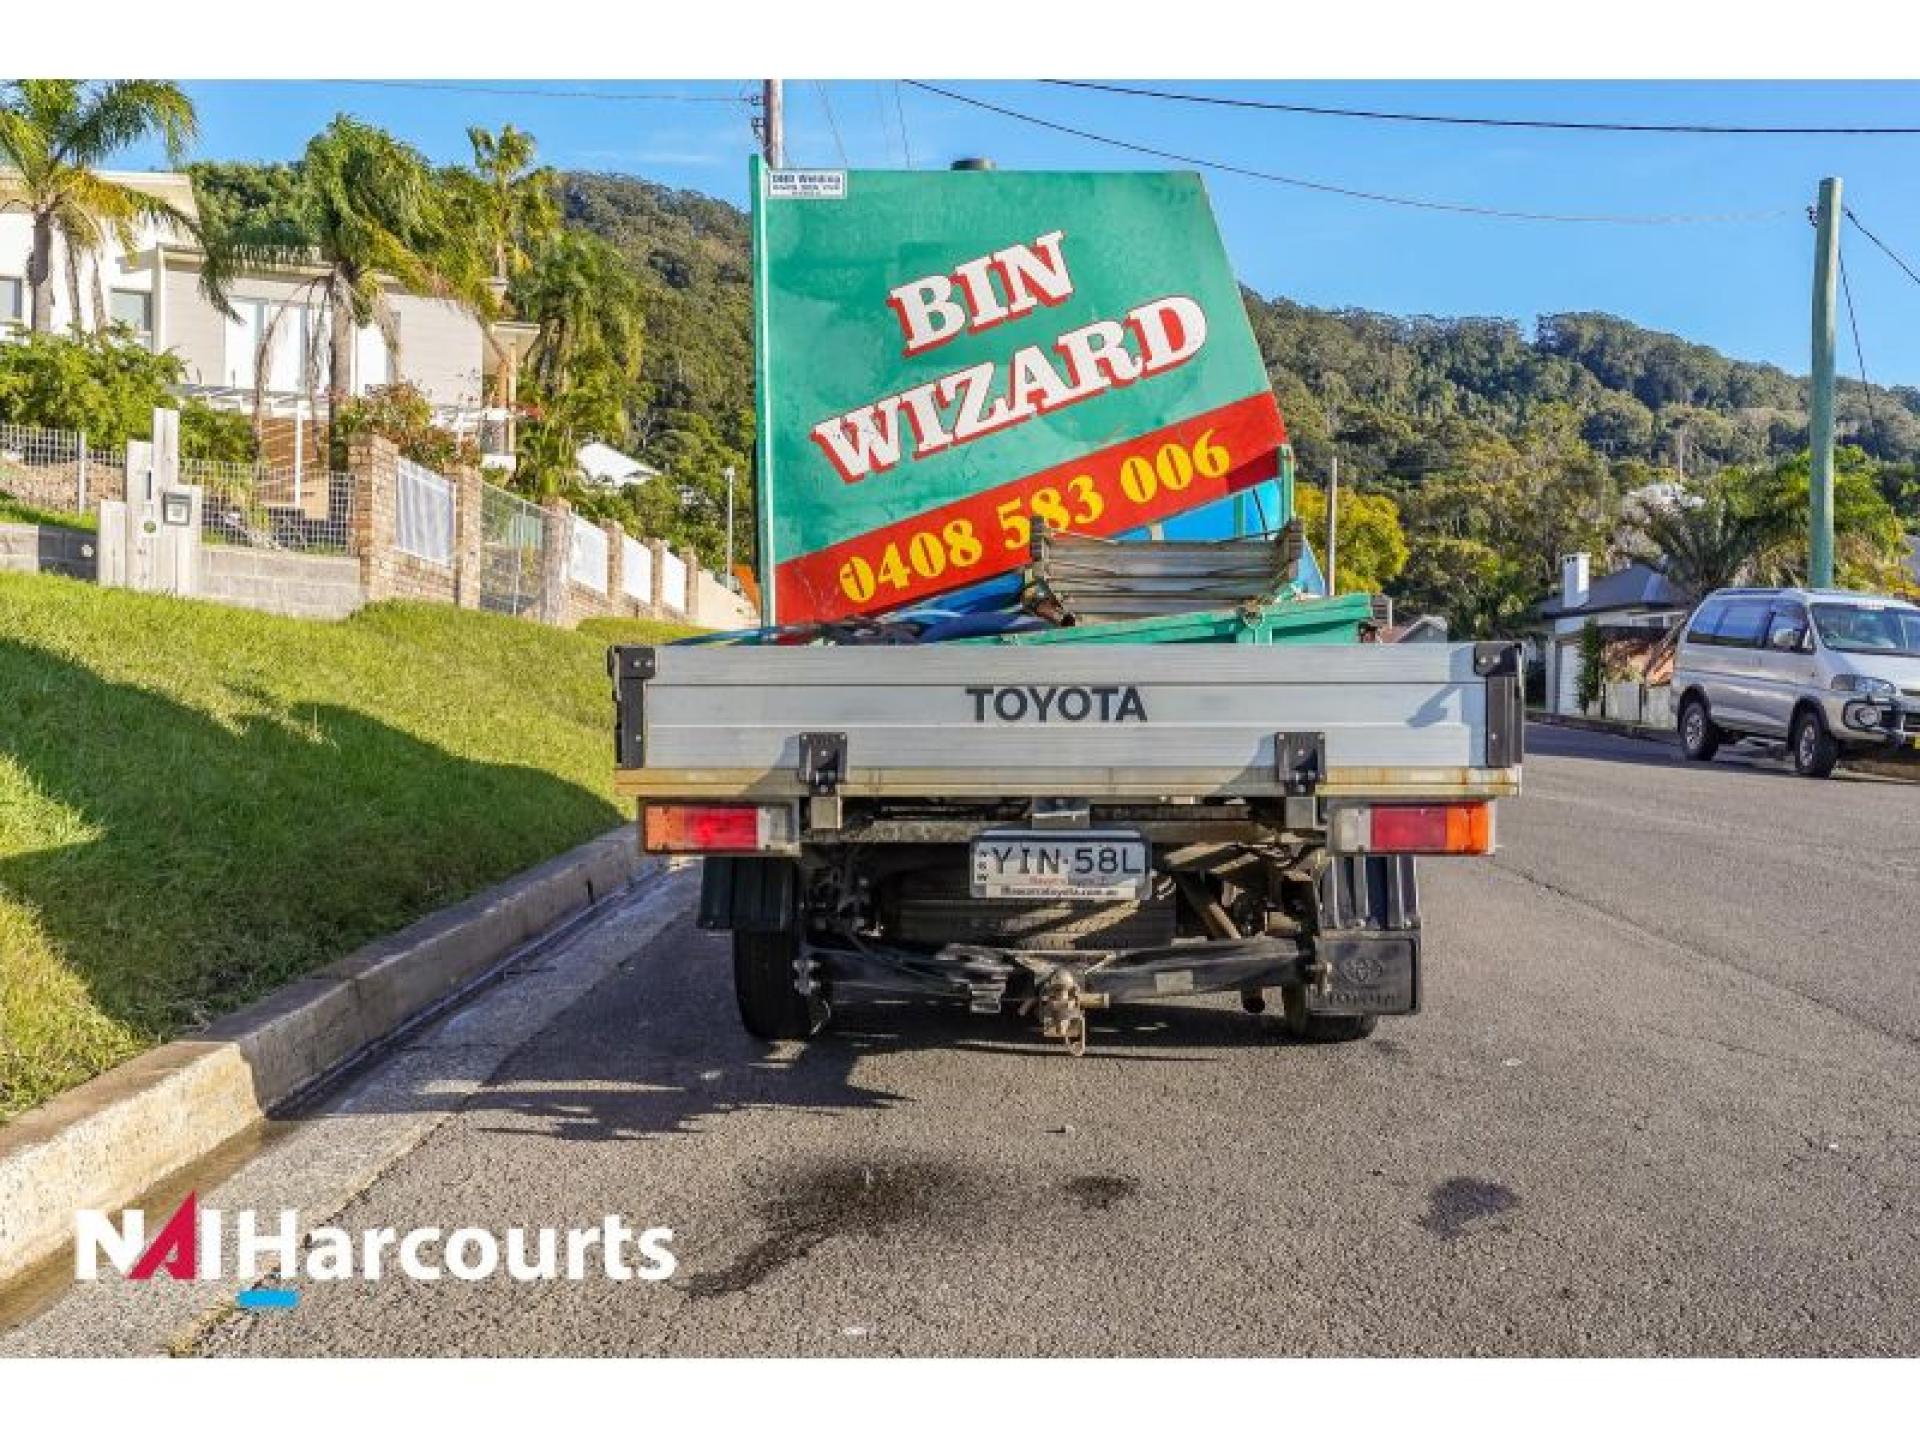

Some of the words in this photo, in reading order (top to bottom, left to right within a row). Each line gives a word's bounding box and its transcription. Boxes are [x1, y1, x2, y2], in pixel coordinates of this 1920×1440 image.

[889, 231, 1073, 356] BIN
[811, 296, 1207, 483] WIZARD
[839, 519, 982, 602] 0408
[996, 475, 1104, 551] 583
[1120, 429, 1230, 503] 006
[966, 687, 1147, 722] TOYOTA
